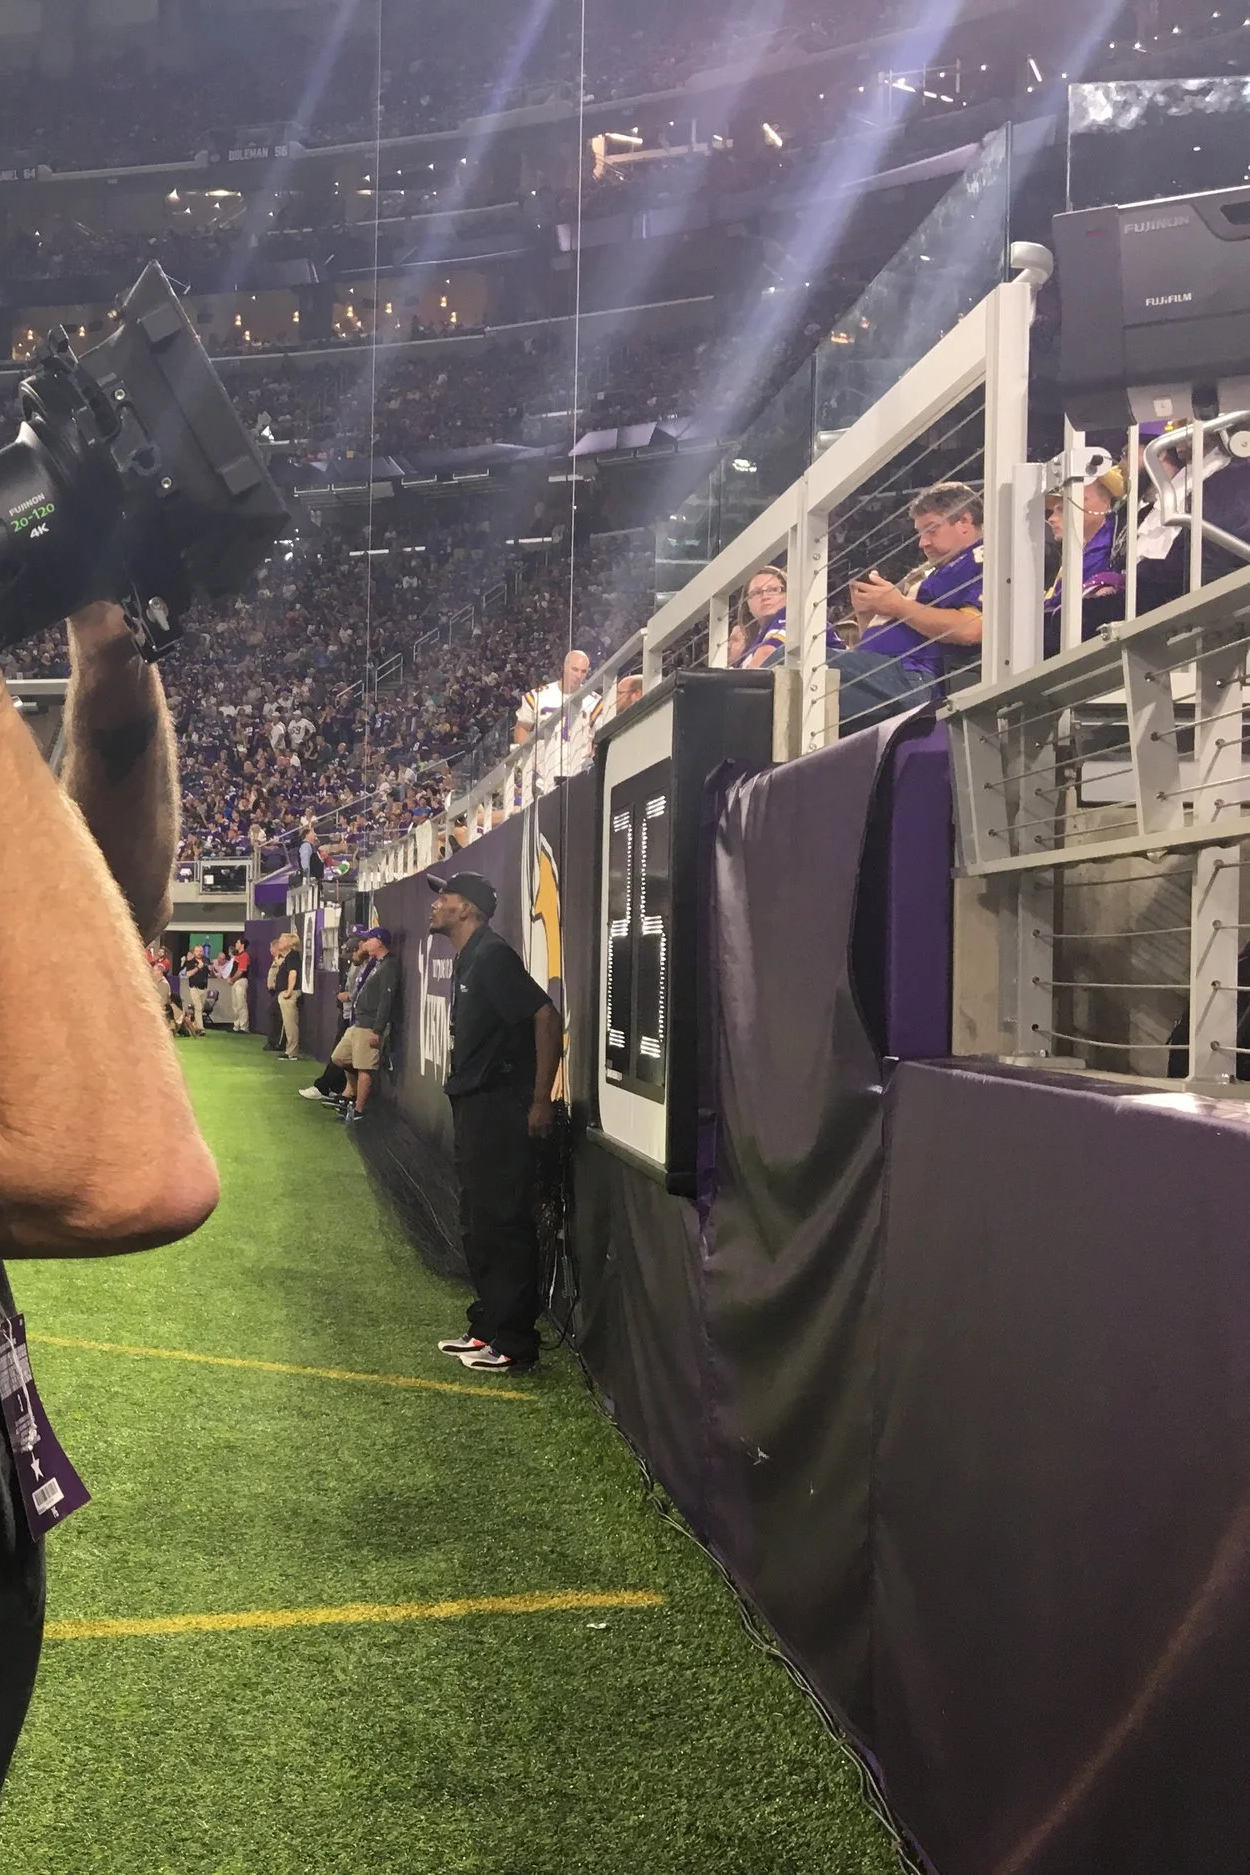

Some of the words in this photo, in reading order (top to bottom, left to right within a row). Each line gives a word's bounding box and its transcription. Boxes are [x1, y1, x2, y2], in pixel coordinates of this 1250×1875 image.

[1123, 215, 1190, 234] FUJINON
[1145, 292, 1192, 307] FUJIFILM
[9, 492, 45, 517] FUJINON
[10, 503, 55, 533] 20-120
[30, 522, 49, 538] 4K
